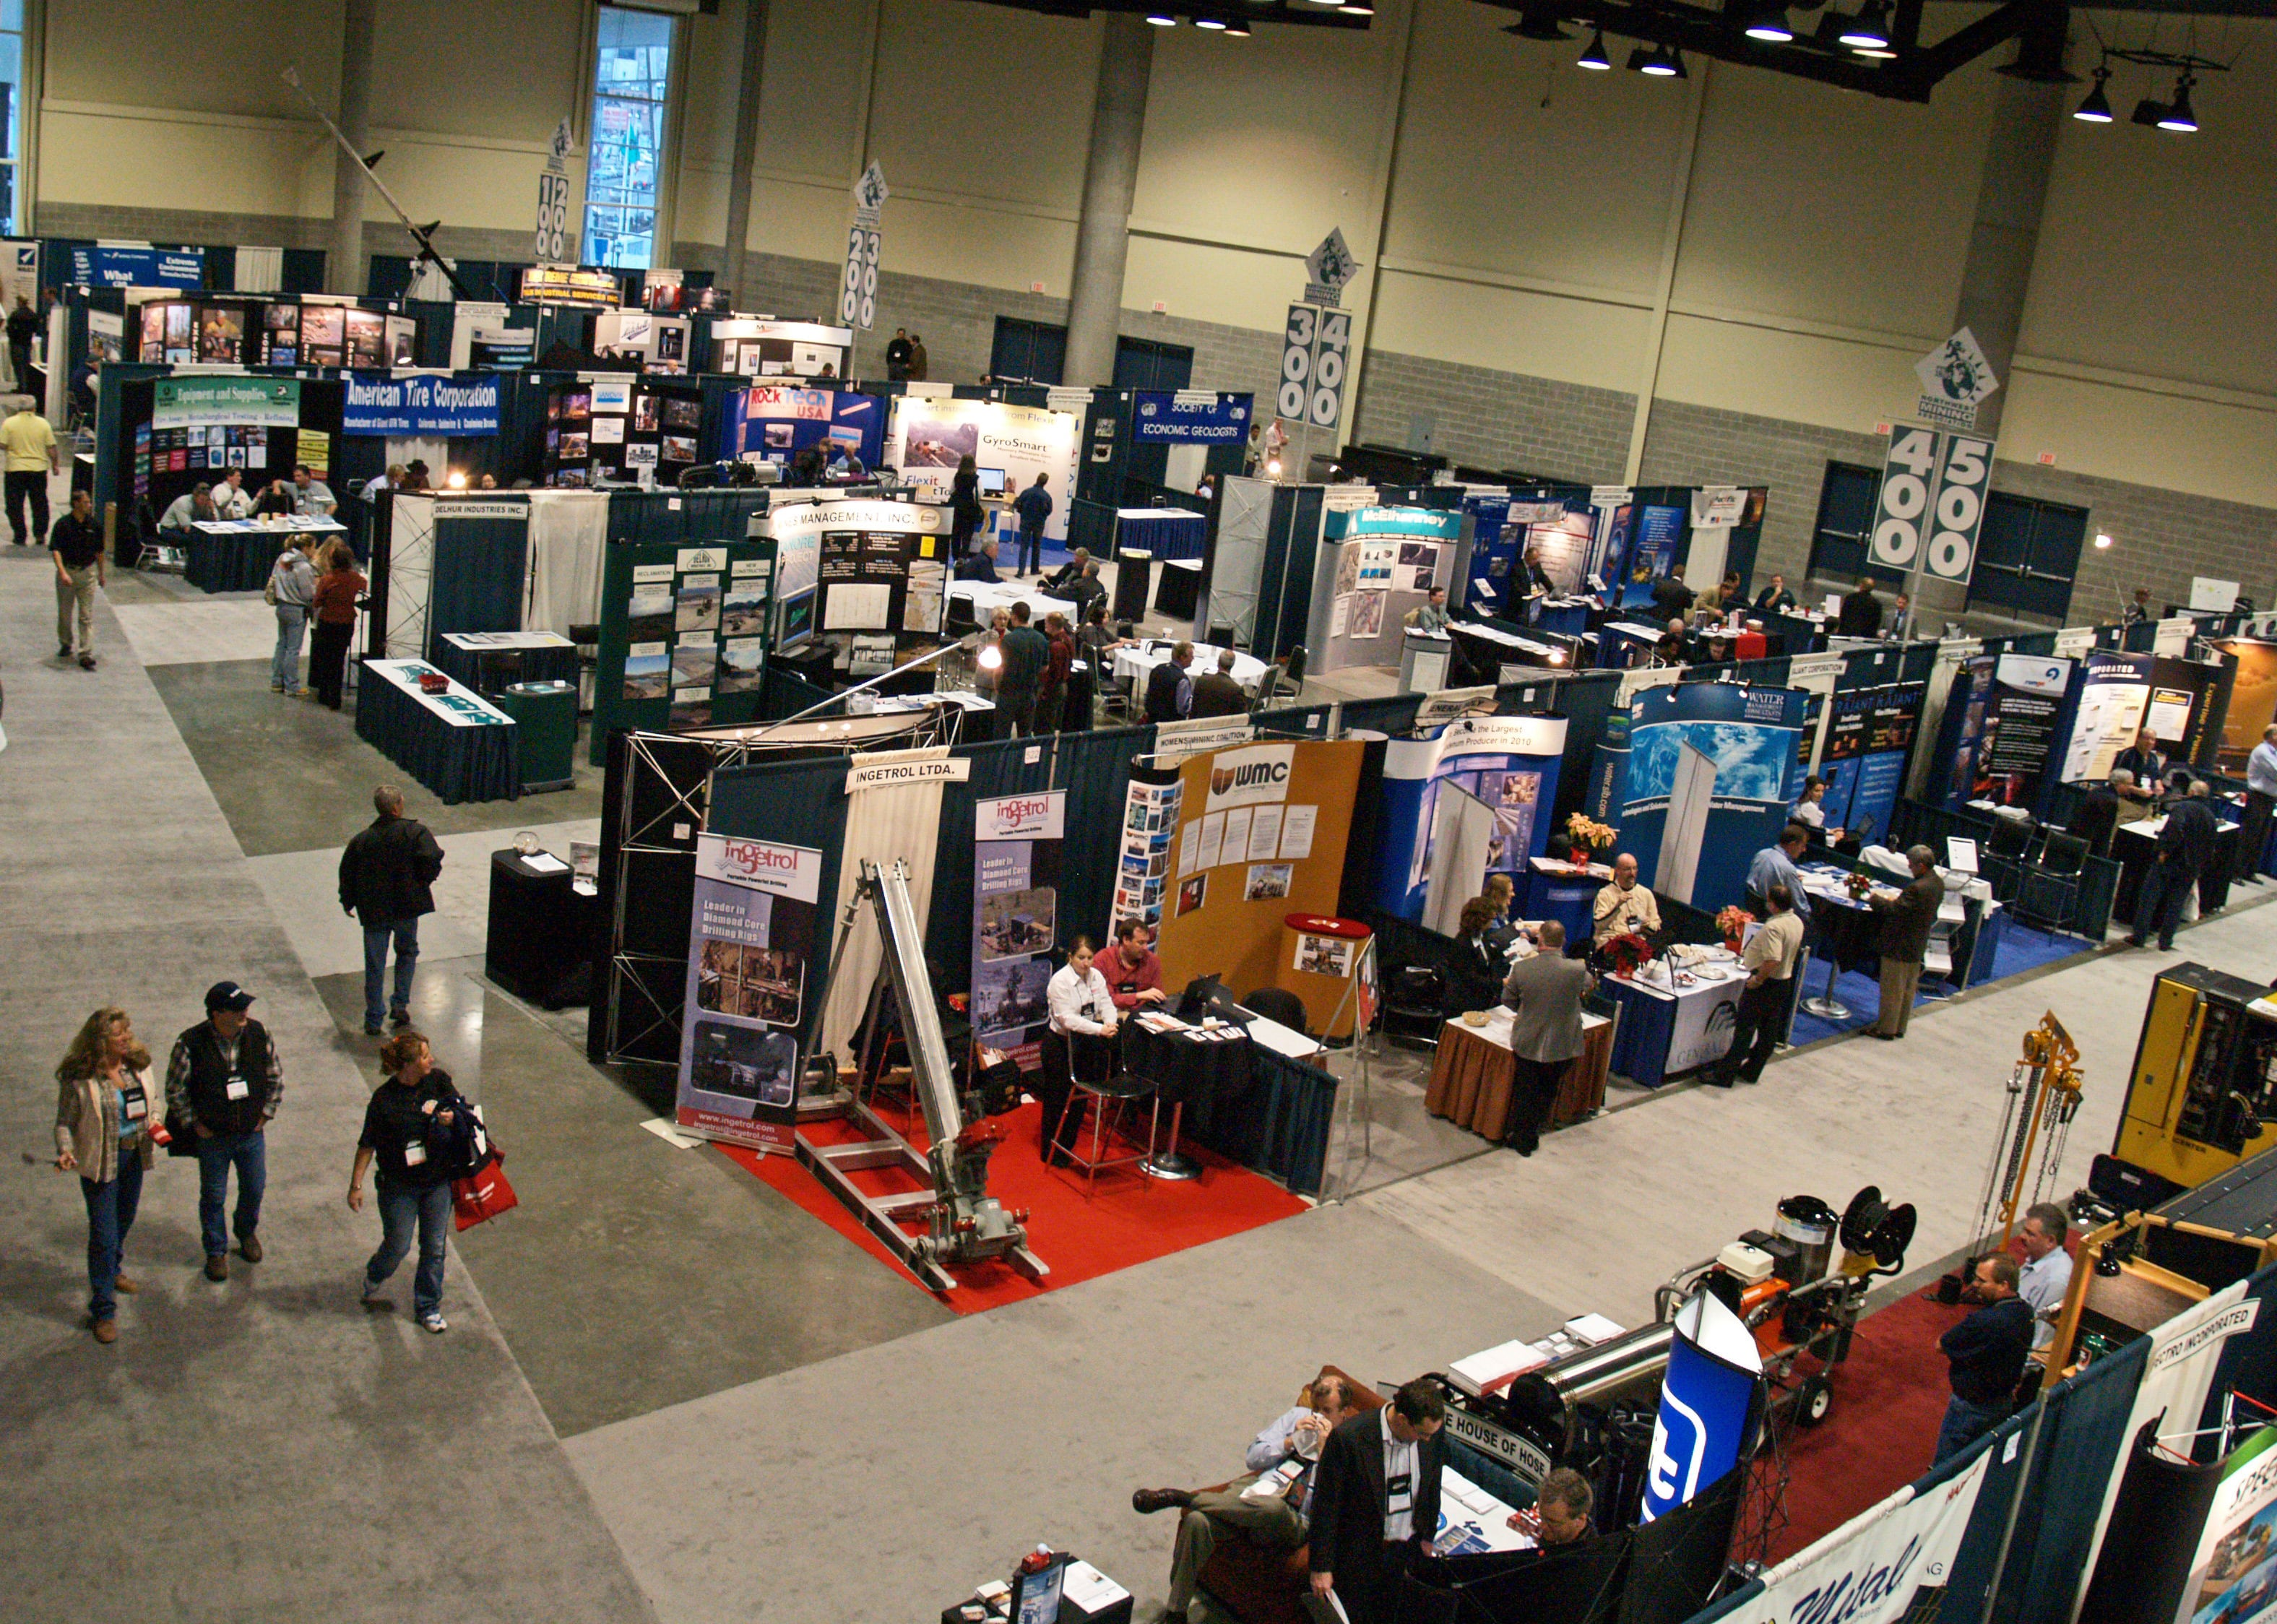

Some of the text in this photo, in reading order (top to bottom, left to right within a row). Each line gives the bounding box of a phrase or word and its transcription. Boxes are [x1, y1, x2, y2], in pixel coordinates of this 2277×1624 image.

[537, 177, 550, 255] 100
[551, 179, 568, 259] 200
[157, 264, 200, 273] Environment
[165, 256, 197, 266] Extreme
[103, 269, 133, 282] What
[844, 230, 863, 321] 200
[861, 233, 879, 327] 300
[571, 290, 606, 301] SERVICES
[1278, 309, 1315, 418] 300
[1312, 315, 1348, 425] 400
[178, 386, 267, 403] Equipment and Supplies
[347, 378, 496, 413] American Tire Corporation
[188, 413, 230, 421] Metallurgical
[232, 413, 258, 421] Testing
[264, 413, 294, 422] Refining
[797, 405, 824, 418] USA
[1919, 402, 1974, 420] MINING
[1143, 423, 1190, 435] ECONOMIC
[982, 435, 1047, 452] GyroSmart
[906, 475, 938, 485] Flexit
[1875, 429, 1934, 565] 400
[1928, 439, 1987, 577] 500
[888, 514, 915, 524] INC.
[1362, 510, 1447, 527] McElhanney
[1491, 725, 1522, 734] Largest
[1466, 737, 1498, 746] Producer
[1511, 737, 1531, 746] 2010
[856, 764, 955, 782] INGETROL LTDA.
[1235, 761, 1288, 787] wmc
[997, 796, 1048, 827] ingetrol
[1724, 802, 1766, 813] Management
[725, 839, 798, 874] ingetrol
[983, 858, 1006, 868] Leader
[982, 866, 1029, 880] Diamond Core
[982, 878, 1023, 891] Drilling Rigs
[704, 900, 735, 914] Leader
[703, 912, 766, 930] Diamond Core
[702, 925, 758, 941] Drilling Rigs
[694, 1120, 779, 1143] ingetrol@ingetrol.com
[699, 1113, 775, 1133] www.ingetrol.com
[1456, 1417, 1545, 1477] HOUSE OF HOSE
